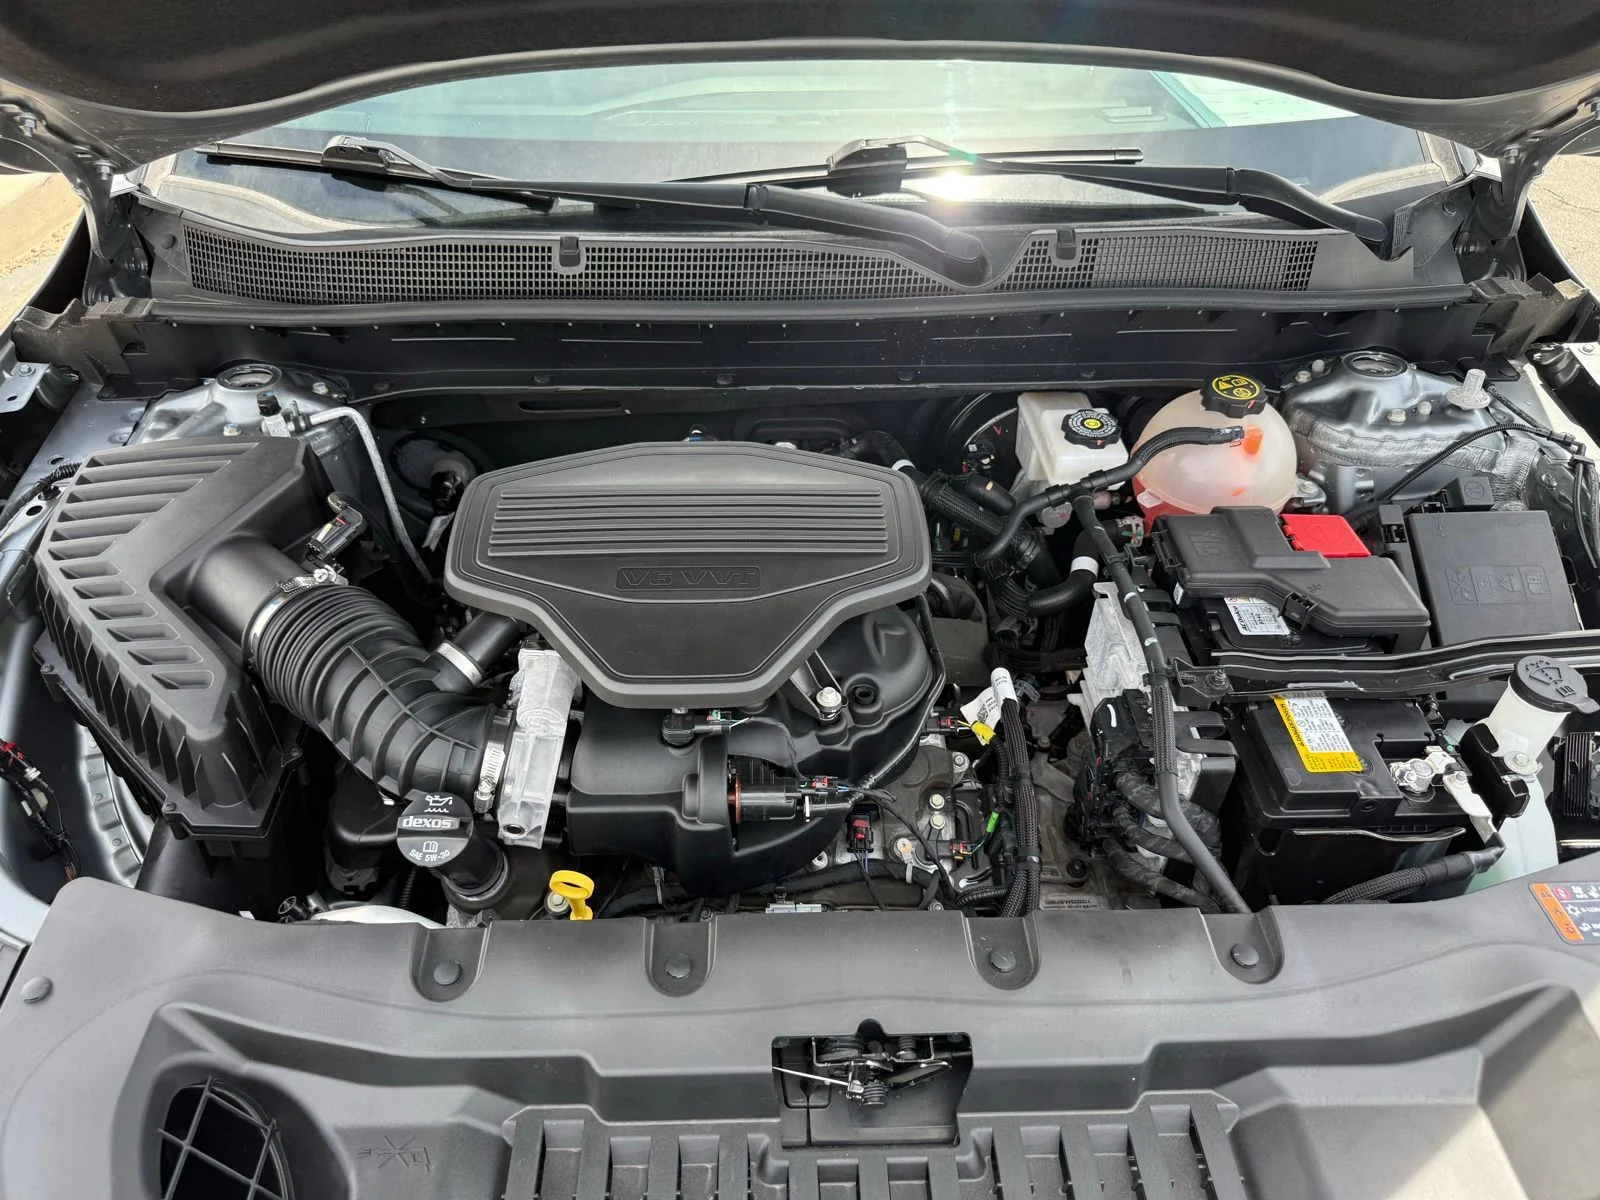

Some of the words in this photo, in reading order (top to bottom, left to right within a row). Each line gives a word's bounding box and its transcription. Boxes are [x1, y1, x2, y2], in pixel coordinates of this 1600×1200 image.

[622, 570, 673, 585] V6
[681, 570, 756, 585] VVT
[402, 816, 453, 829] dexos
[409, 849, 423, 860] SAE
[425, 850, 450, 862] 5W-30
